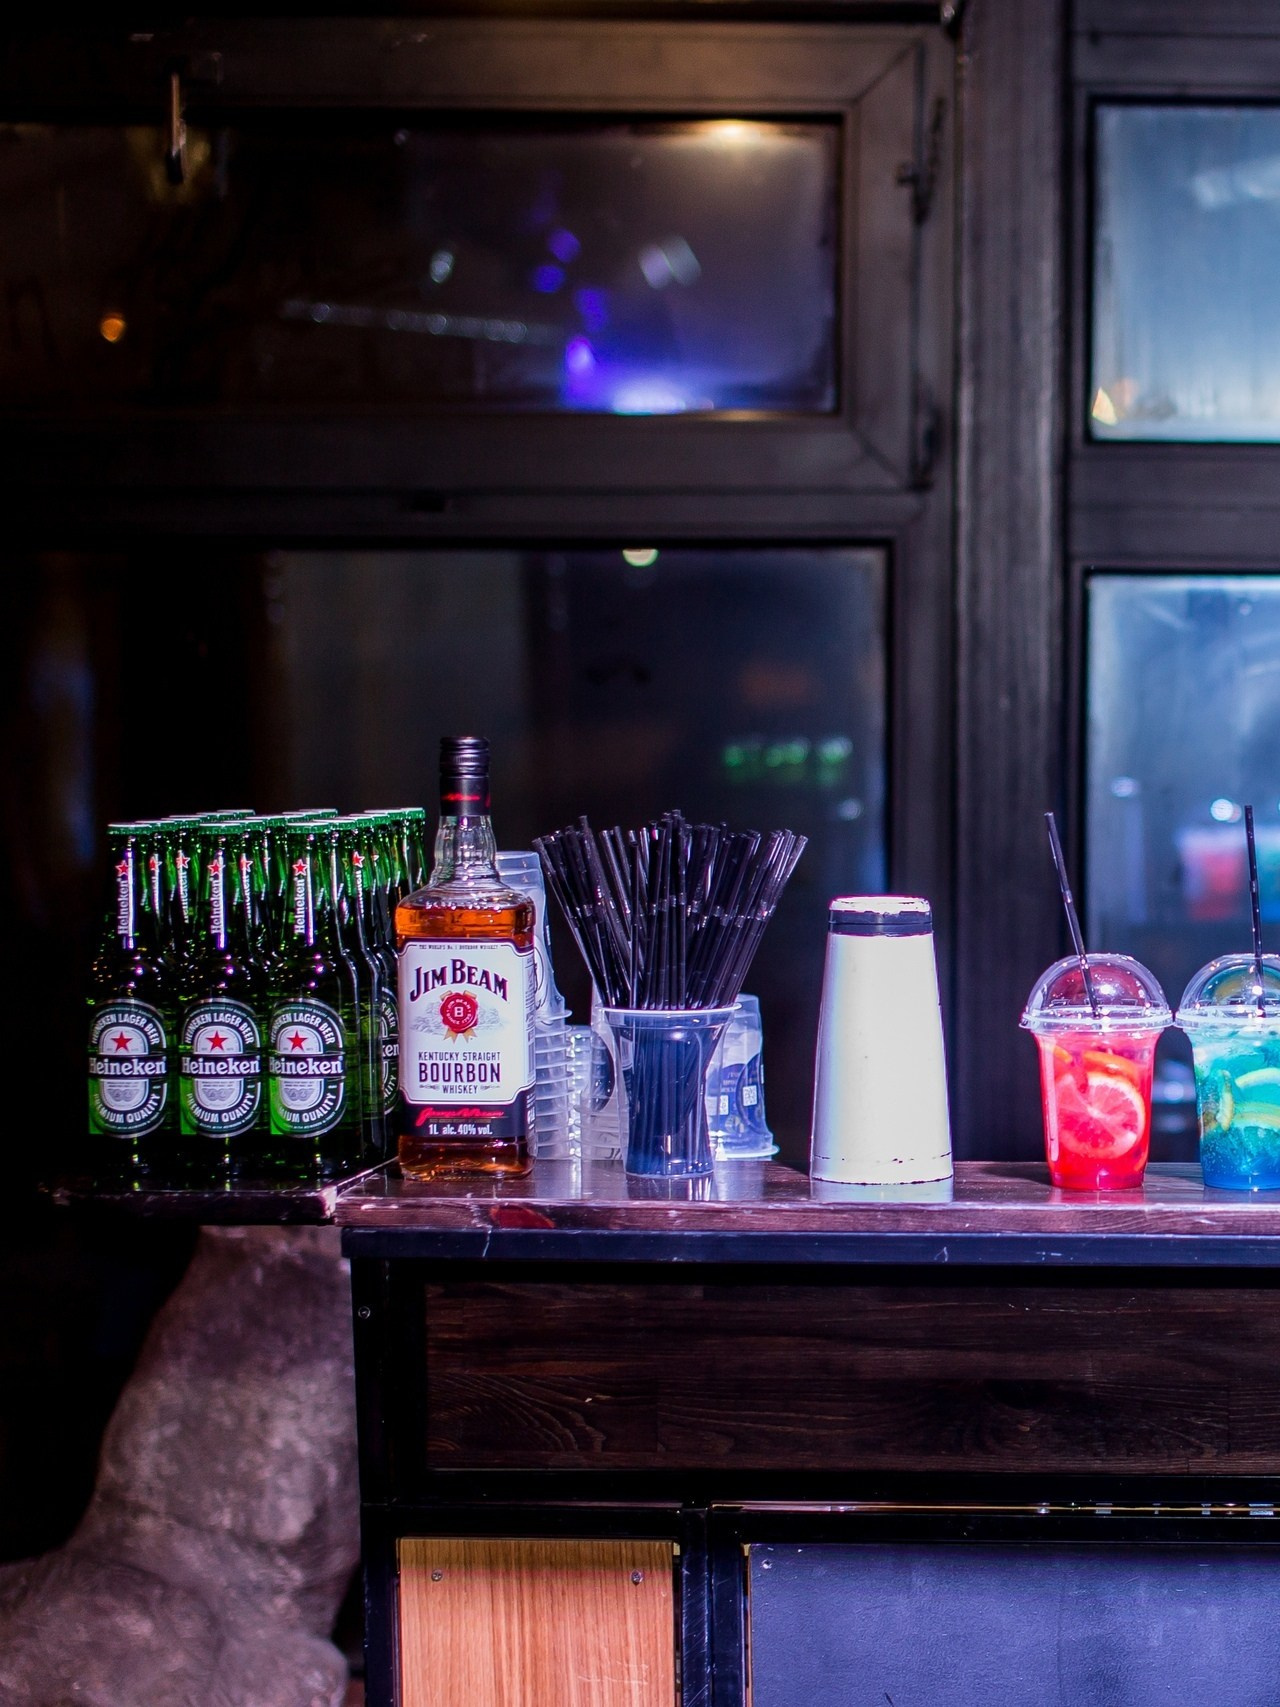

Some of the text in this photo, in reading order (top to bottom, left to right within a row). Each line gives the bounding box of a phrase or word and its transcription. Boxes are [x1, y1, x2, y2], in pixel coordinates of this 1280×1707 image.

[294, 878, 306, 934] Heineken
[409, 966, 448, 1002] JIM
[450, 958, 508, 1002] BEAM
[385, 1007, 396, 1028] BEER
[454, 1006, 464, 1017] B
[118, 1013, 147, 1028] LAGER
[144, 1023, 160, 1045] BEER
[185, 1013, 211, 1044] HEINEKEN
[213, 1012, 242, 1027] LAGER
[239, 1023, 254, 1044] BEER
[293, 1012, 322, 1026] LAGER
[318, 1022, 336, 1045] BEER
[89, 1056, 167, 1076] Heineken
[182, 1056, 260, 1076] Heineken
[269, 1056, 343, 1076] Heineken
[418, 1051, 501, 1061] KENTUCKY STRAIGHT
[418, 1062, 501, 1083] BOURBON
[442, 1084, 478, 1095] WHISKEY
[126, 1093, 161, 1123] QUALITY
[221, 1093, 255, 1122] QUALITY
[302, 1092, 336, 1122] QUALITY
[428, 1123, 439, 1135] 1L
[458, 1123, 476, 1135] 40%
